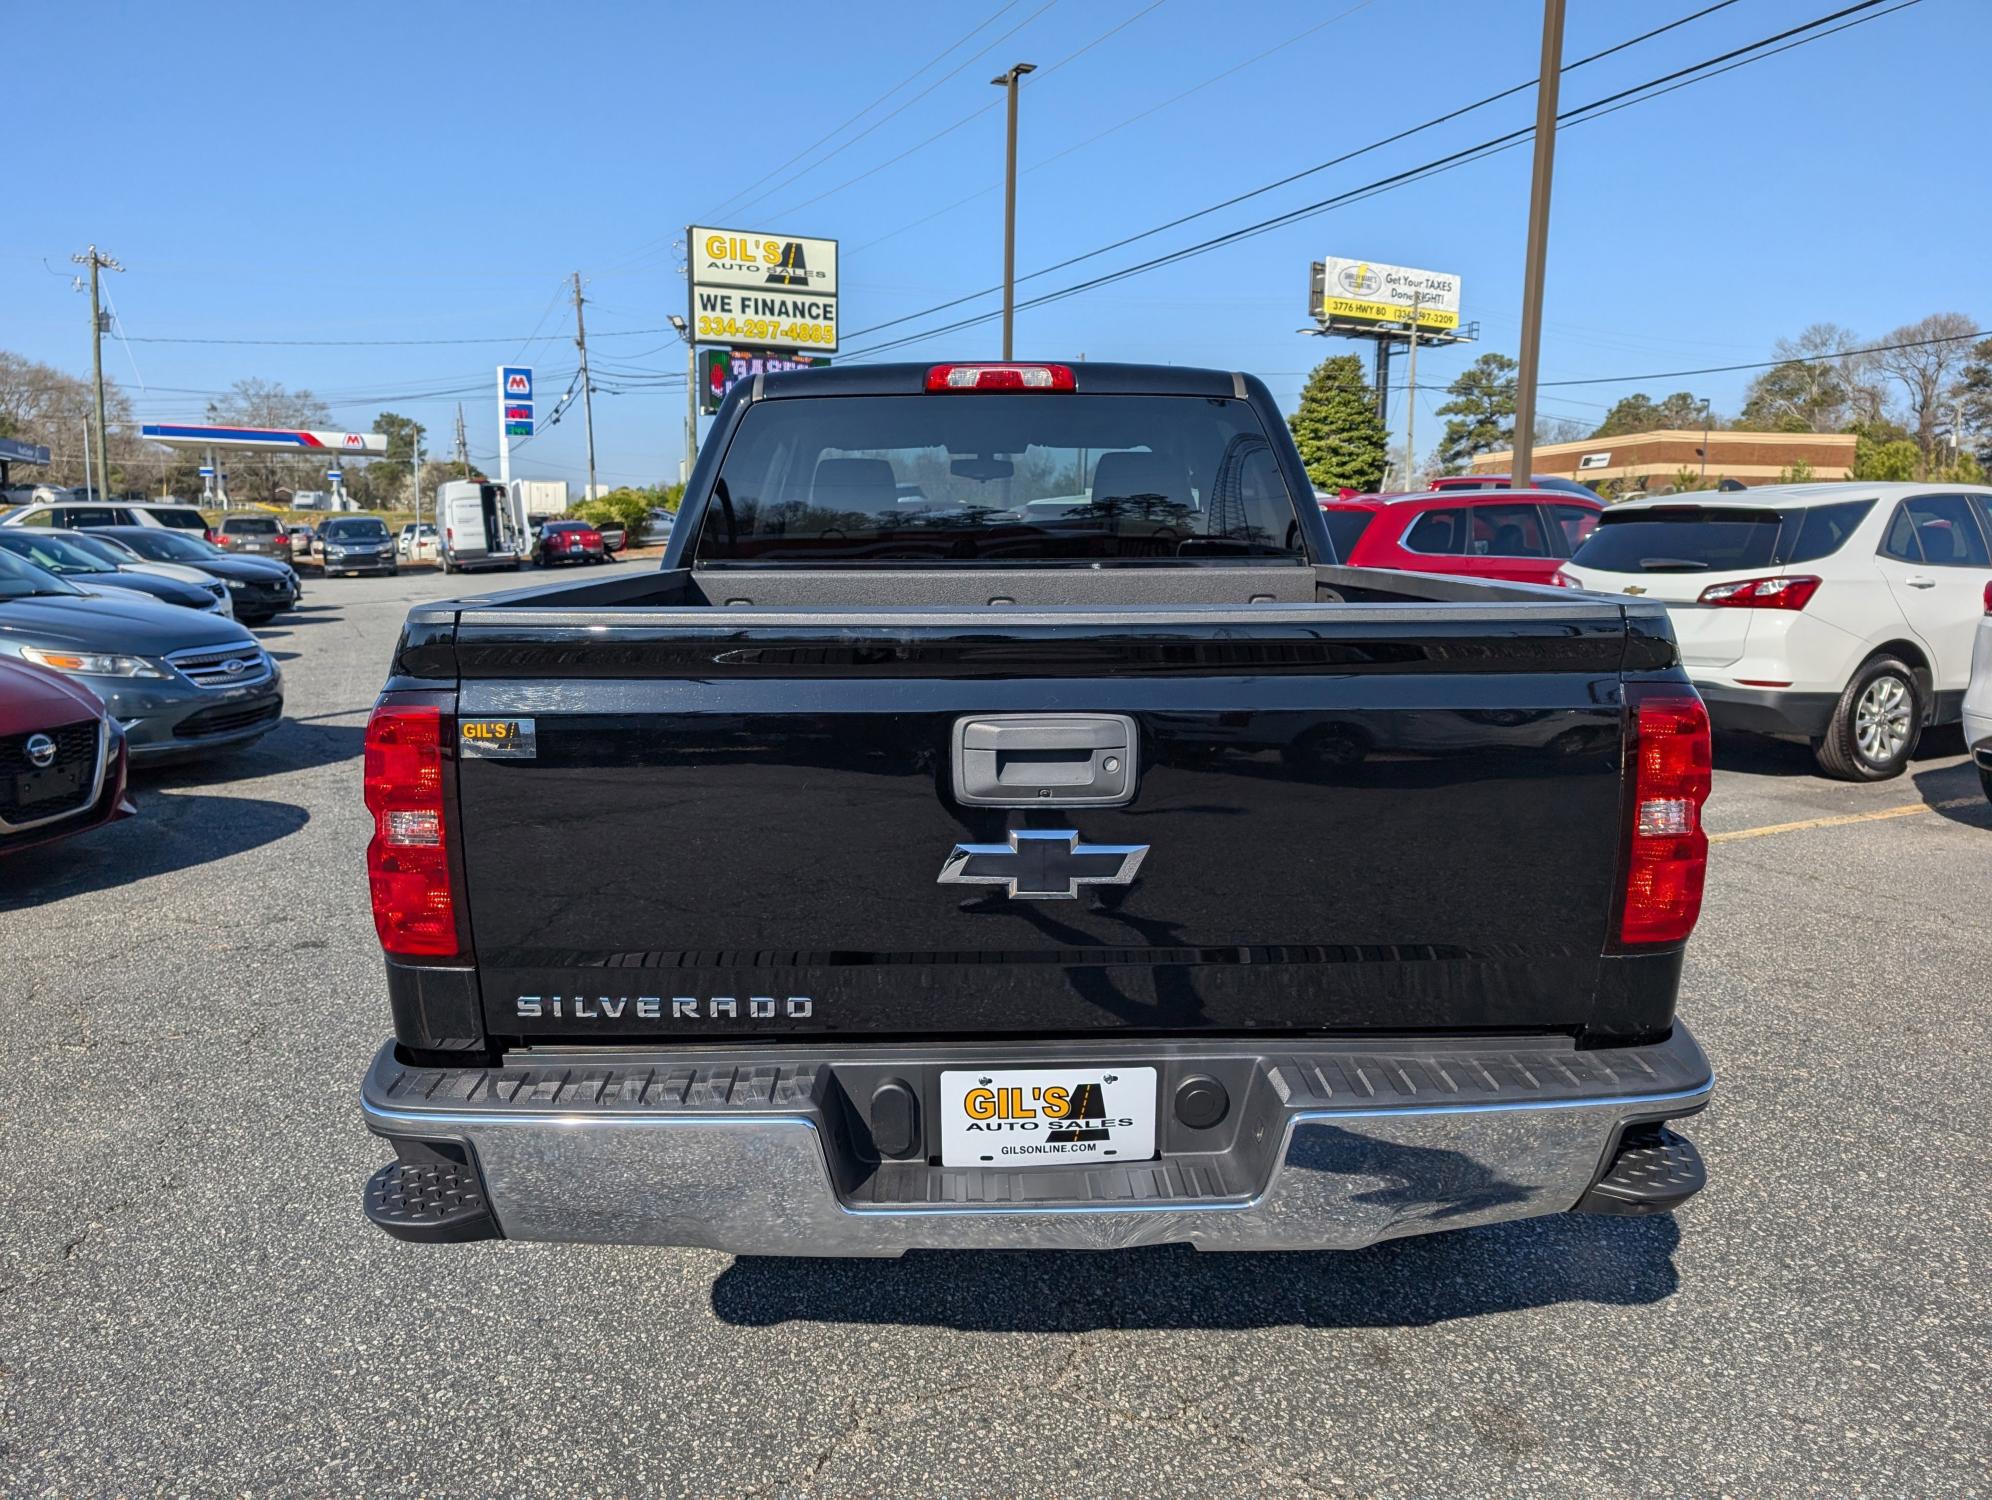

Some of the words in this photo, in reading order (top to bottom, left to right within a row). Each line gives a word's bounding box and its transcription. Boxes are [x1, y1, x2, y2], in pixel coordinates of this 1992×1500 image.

[705, 235, 783, 266] GIL'S
[707, 261, 761, 273] AUTO
[766, 266, 827, 279] SALES
[1385, 272, 1401, 285] Get
[1403, 275, 1424, 288] Your
[1425, 278, 1452, 292] TAXES
[1391, 287, 1414, 301] Done
[699, 292, 733, 314] WE
[741, 296, 835, 321] FINANCE
[1333, 300, 1354, 312] 3776
[1355, 303, 1375, 315] HWY
[1375, 306, 1387, 317] 80
[698, 315, 834, 344] 334-297-4885
[463, 722, 508, 738] GIL'S
[516, 996, 813, 1018] SILVERADO
[963, 1086, 1072, 1121] GIL'S
[965, 1121, 1040, 1132] AUTO
[1047, 1117, 1134, 1130] SALES
[1000, 1143, 1097, 1156] GILSONLINE.COM
